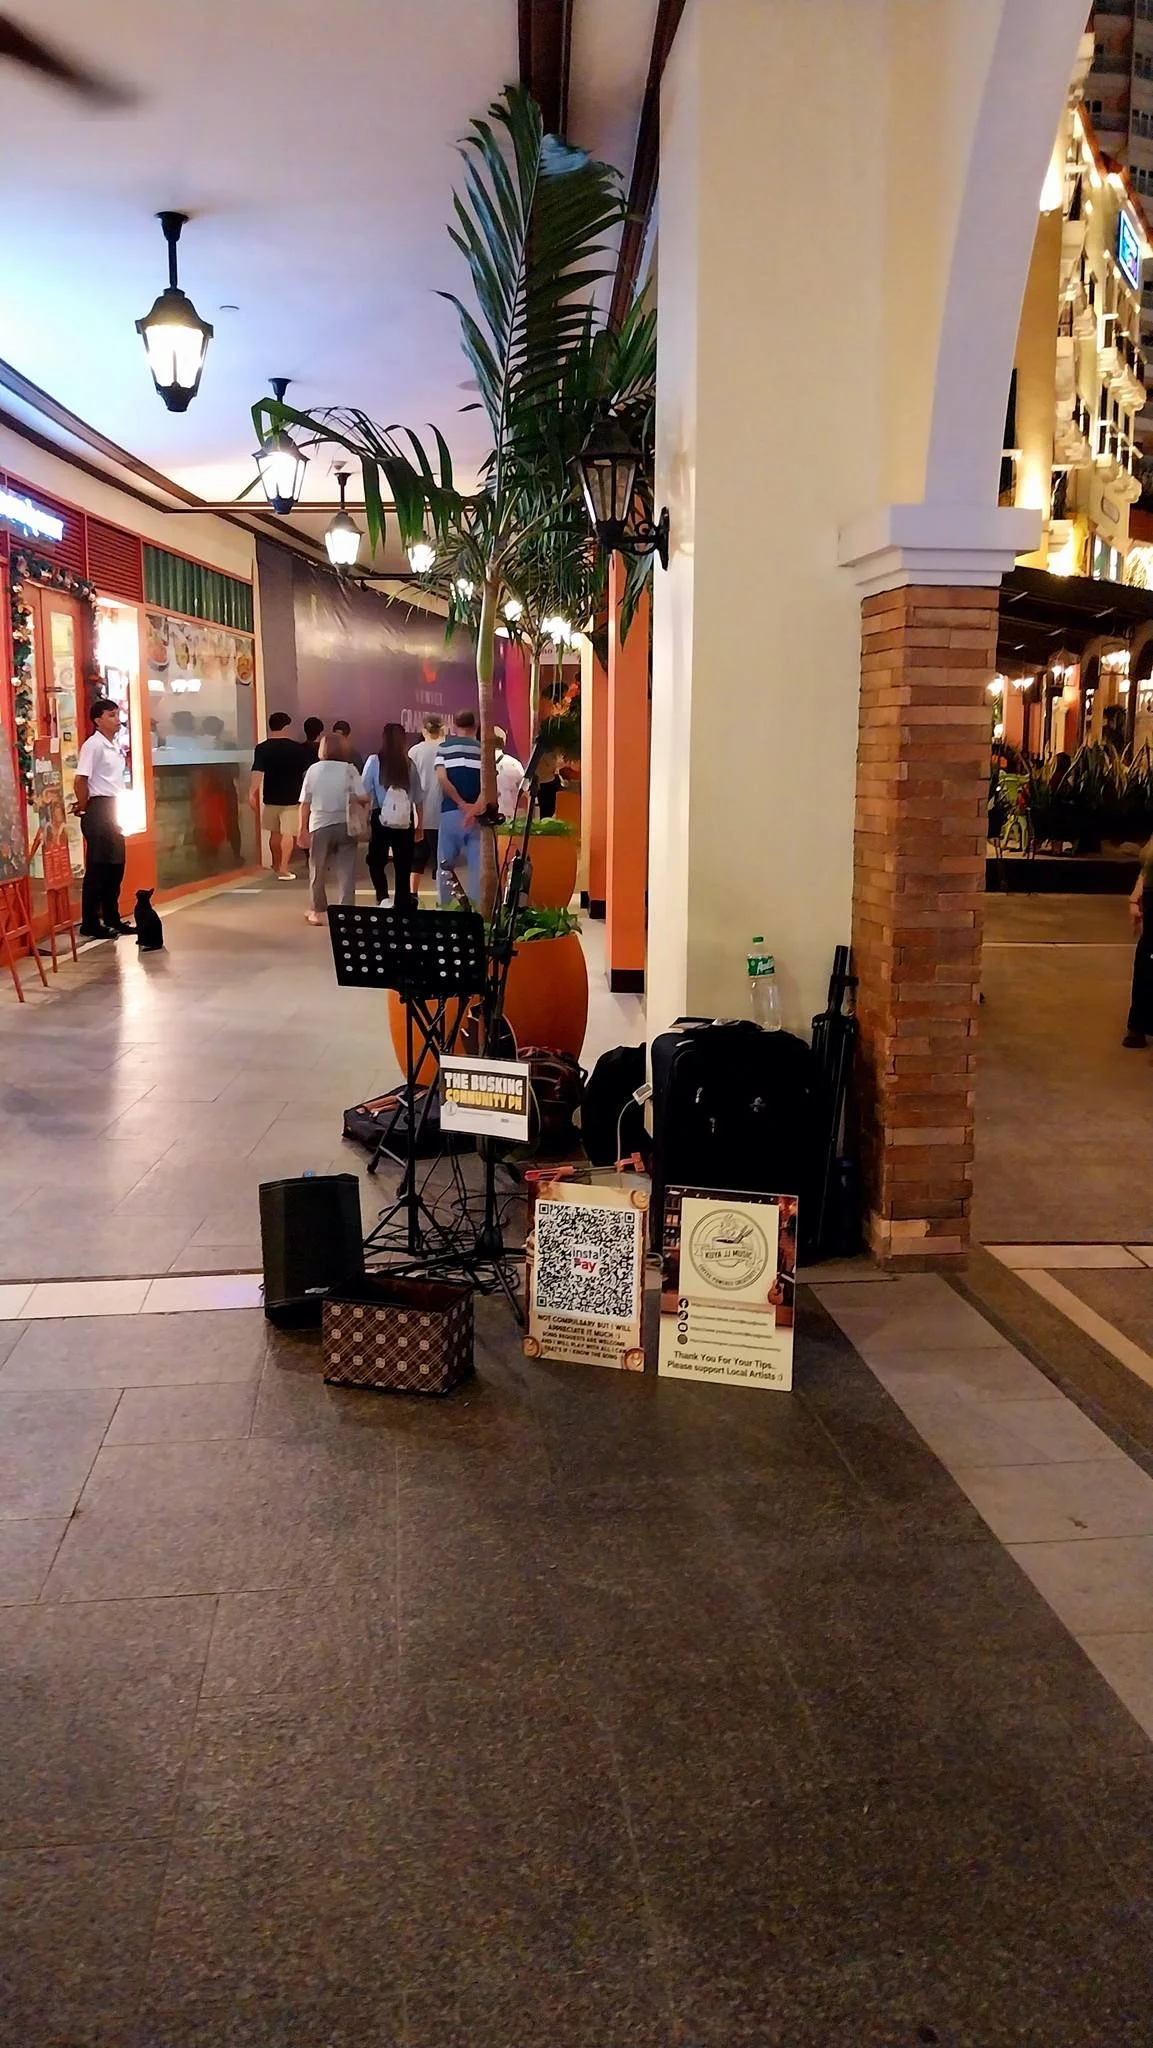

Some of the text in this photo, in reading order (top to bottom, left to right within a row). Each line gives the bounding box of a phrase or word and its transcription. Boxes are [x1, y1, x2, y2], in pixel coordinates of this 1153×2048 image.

[444, 1072, 523, 1096] THE BUSKING
[445, 1088, 522, 1111] COMMUNITY PH
[705, 1249, 722, 1259] KUYA
[732, 1248, 753, 1259] MUSIC
[537, 1314, 551, 1322] NOT
[597, 1321, 609, 1329] BUT
[615, 1324, 632, 1332] WILL
[548, 1324, 585, 1335] APPRECIATE
[586, 1328, 593, 1336] IT
[594, 1330, 614, 1339] MUCH
[673, 1350, 699, 1361] Thank
[700, 1353, 717, 1363] You
[717, 1355, 732, 1365] For
[733, 1357, 753, 1367] Your
[667, 1360, 693, 1371] Please
[694, 1363, 726, 1374] support
[726, 1366, 748, 1377] Local
[748, 1369, 776, 1381] Artists
